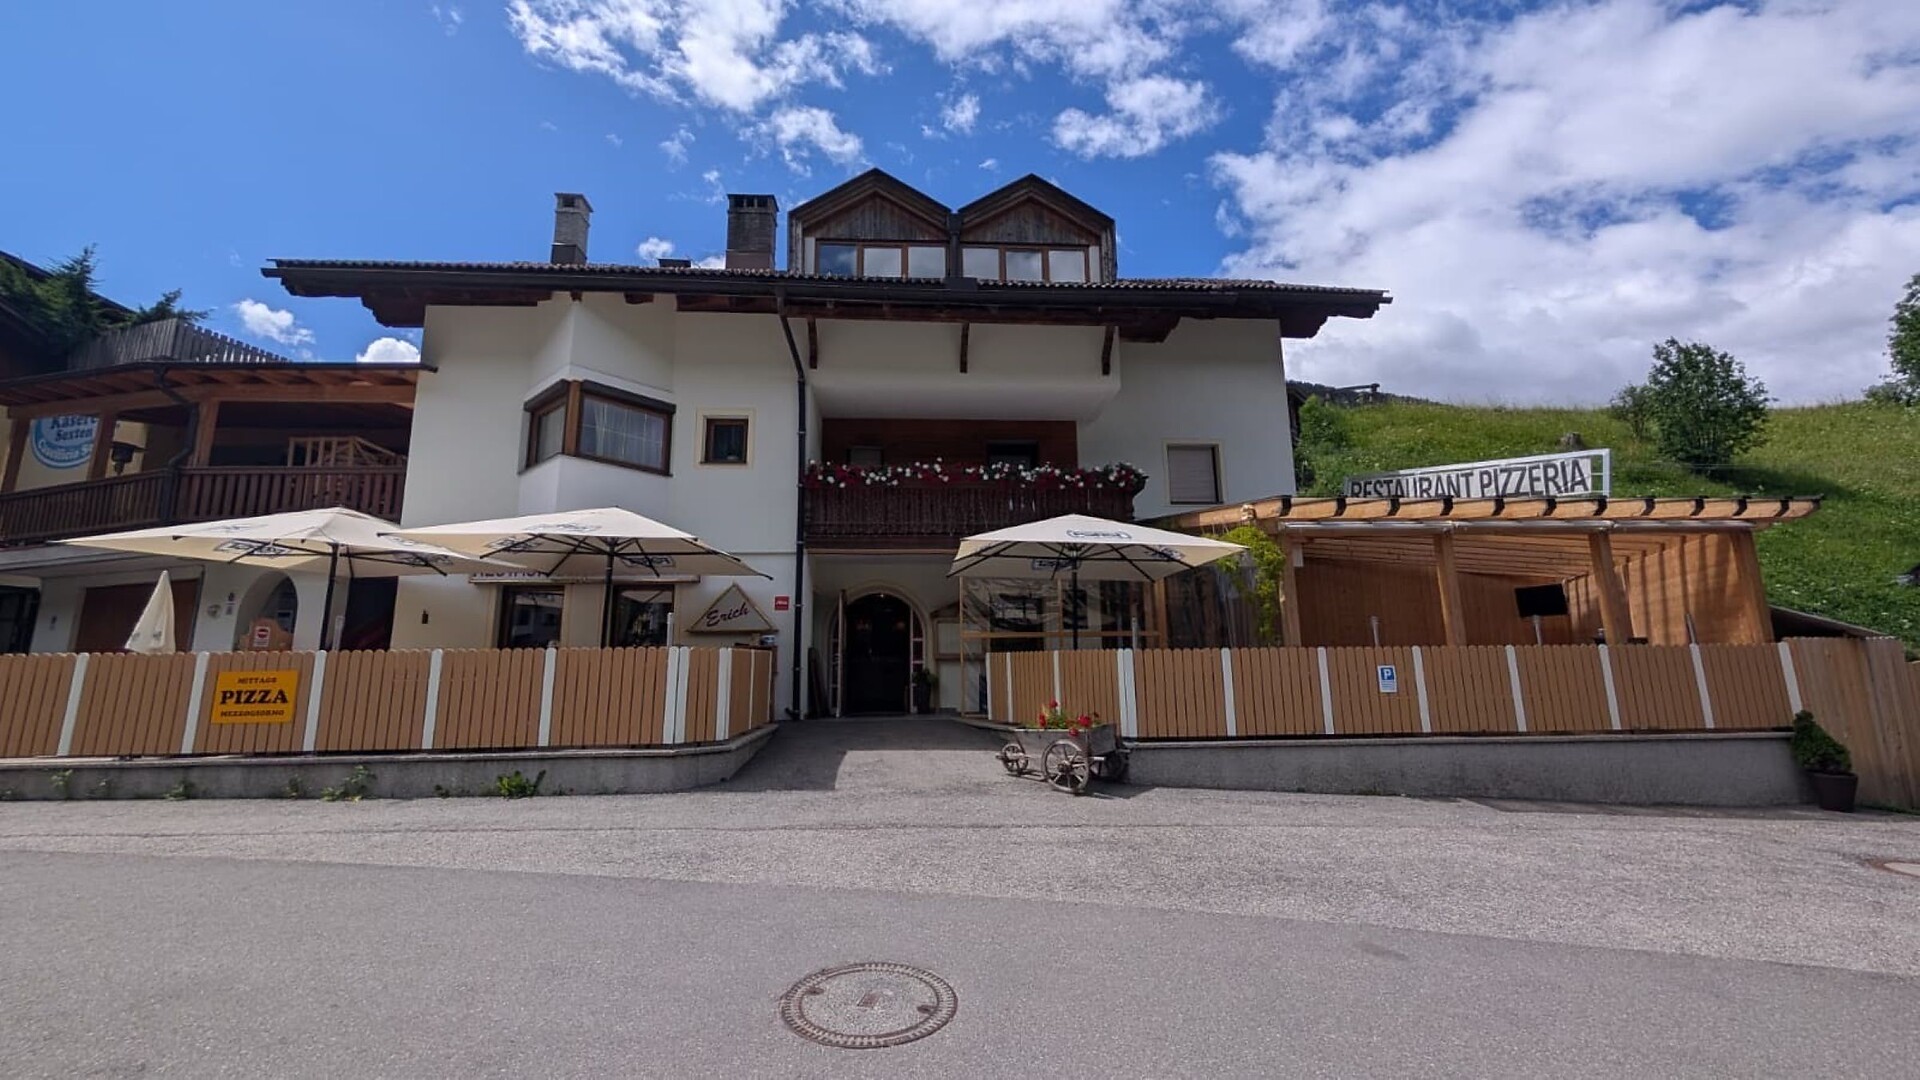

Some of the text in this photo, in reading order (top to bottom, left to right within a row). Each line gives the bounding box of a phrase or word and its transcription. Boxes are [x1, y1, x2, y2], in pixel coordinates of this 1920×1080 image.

[1350, 458, 1590, 499] RESTAURANT PIZZERIA
[706, 602, 750, 627] Erich
[1382, 668, 1392, 680] P
[220, 688, 289, 705] PIZZA
